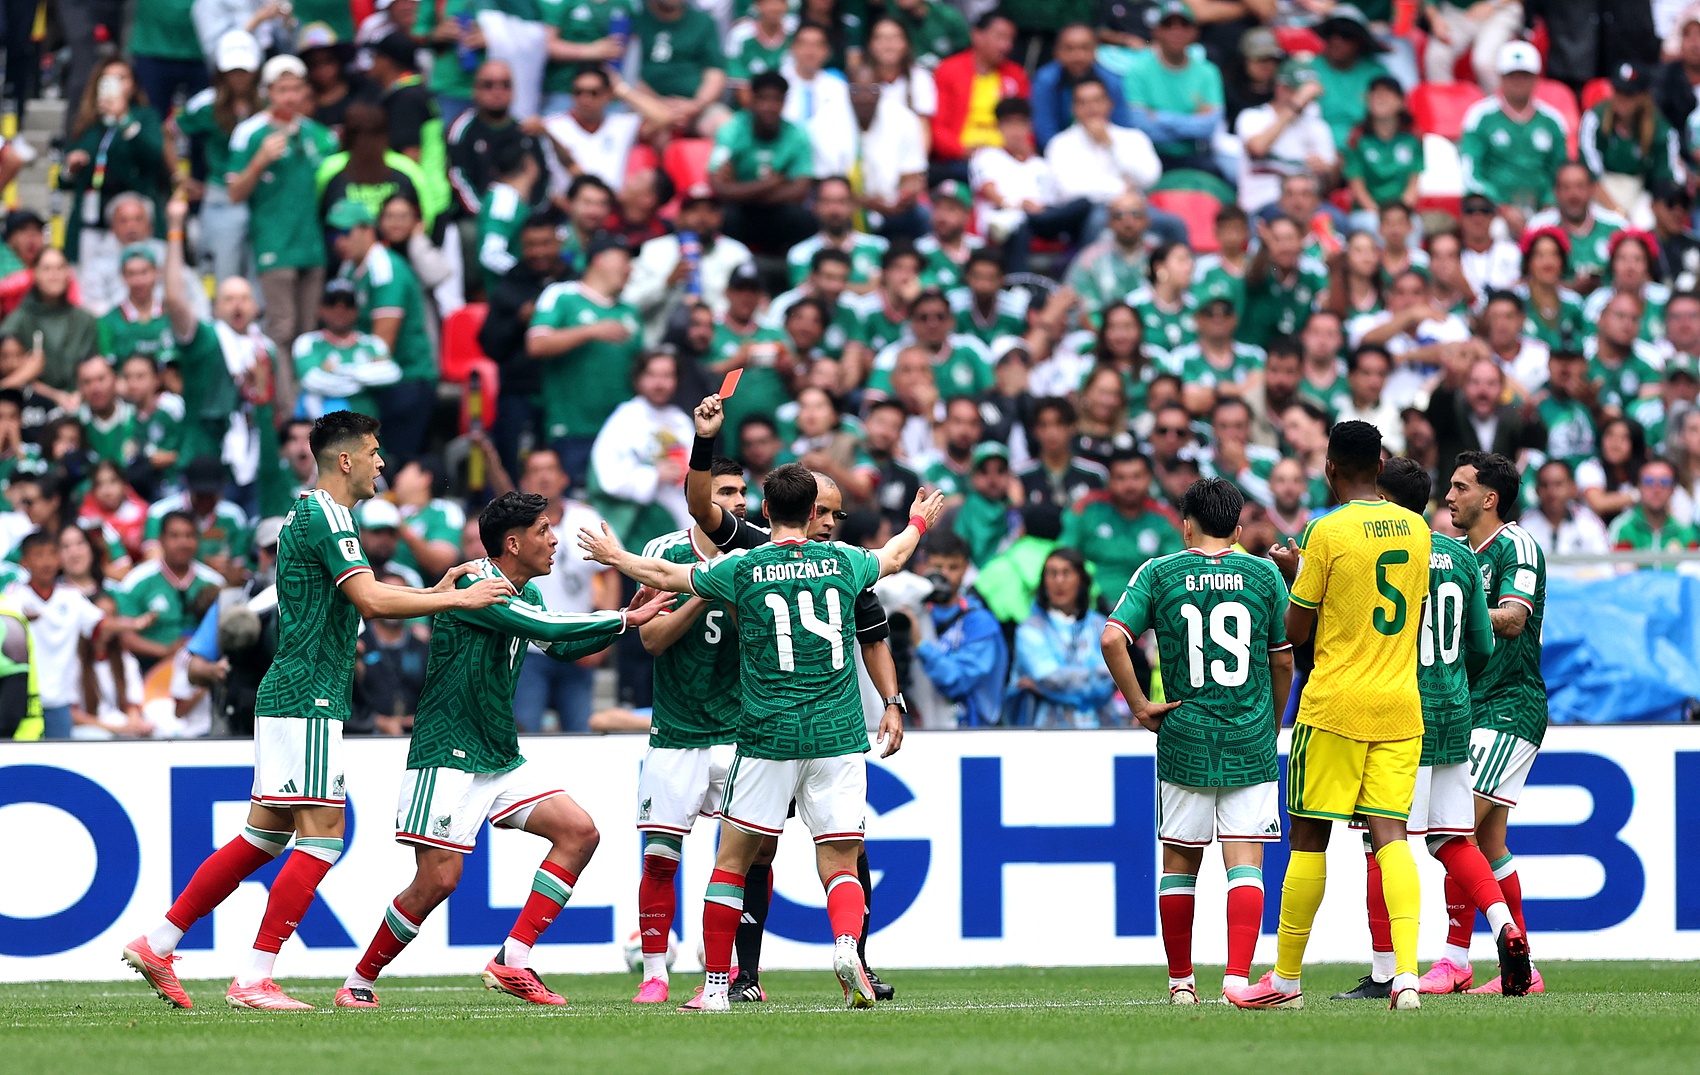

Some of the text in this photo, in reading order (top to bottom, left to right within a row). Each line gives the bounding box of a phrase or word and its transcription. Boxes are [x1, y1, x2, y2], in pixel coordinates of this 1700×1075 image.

[752, 559, 841, 582] A.GONZÁLEZ
[1185, 573, 1244, 591] G.MORA
[1373, 549, 1409, 636] 5
[704, 610, 723, 644] 5
[764, 587, 844, 671] 14
[1180, 601, 1252, 688] 19
[1420, 581, 1463, 667] 10
[447, 753, 1295, 945] LGH
